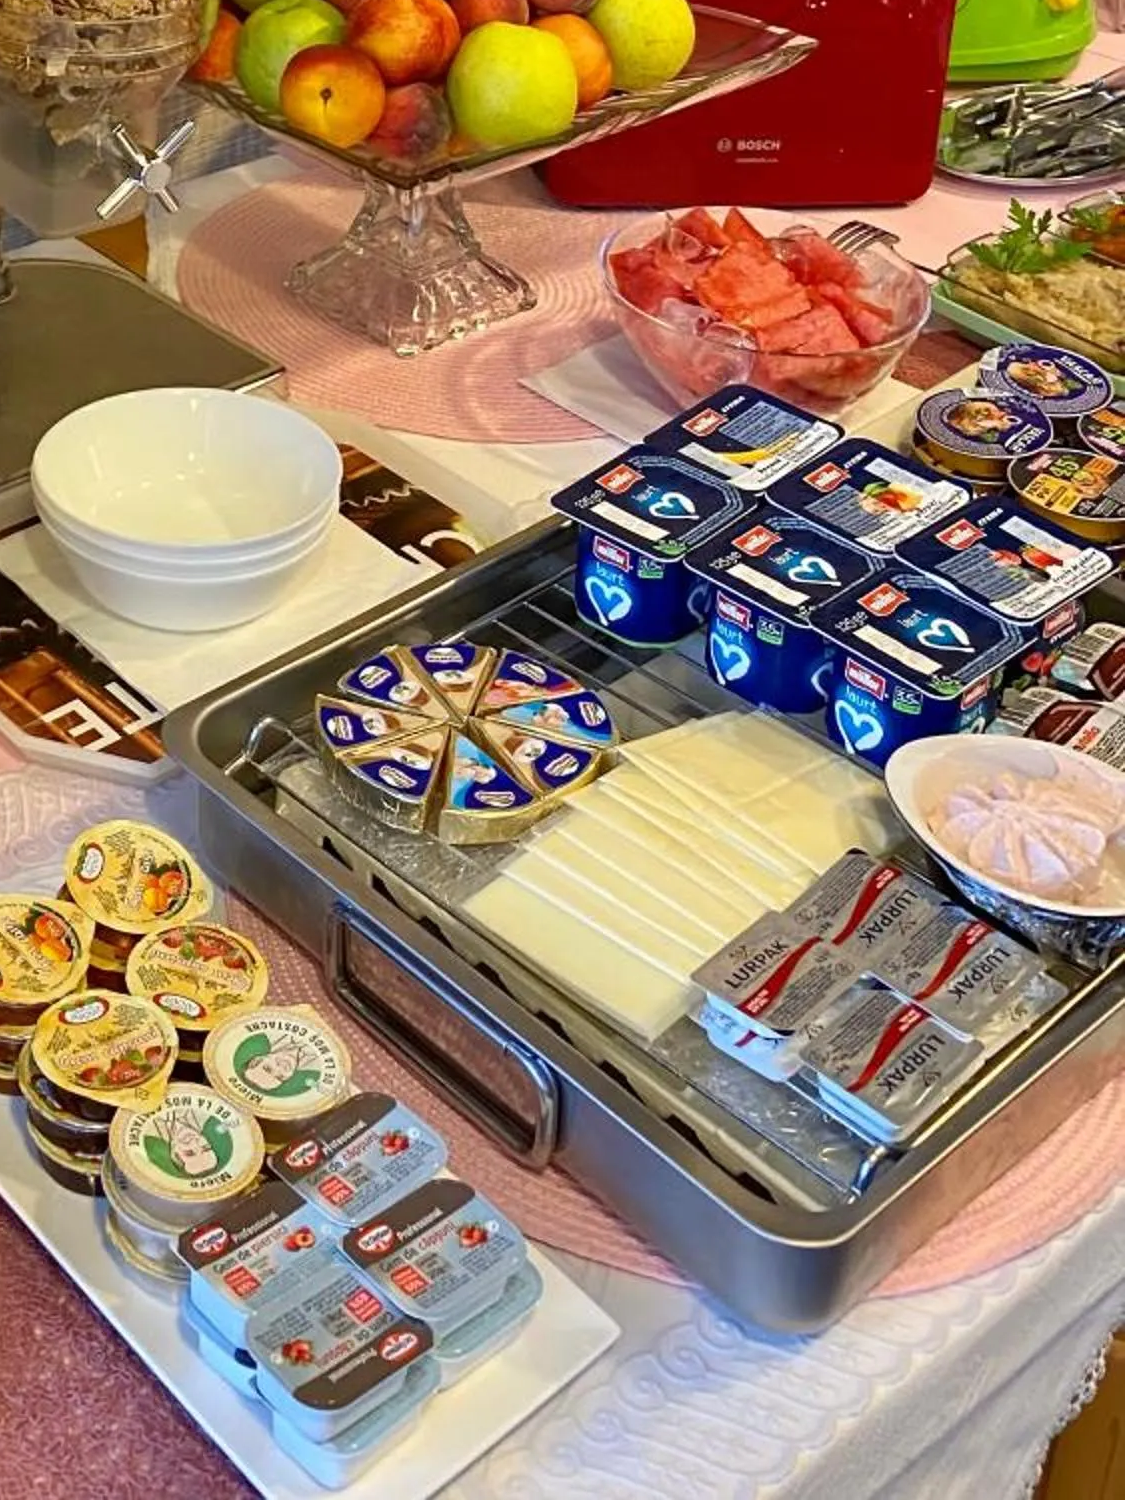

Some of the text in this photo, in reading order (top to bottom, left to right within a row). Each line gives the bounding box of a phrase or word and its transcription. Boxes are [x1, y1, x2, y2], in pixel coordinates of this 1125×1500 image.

[736, 138, 781, 151] BOSCH
[859, 888, 919, 945] LURPAK
[724, 940, 789, 989] LURPAK
[947, 947, 1012, 1002] LURPAK
[878, 1034, 946, 1093] LURPAK
